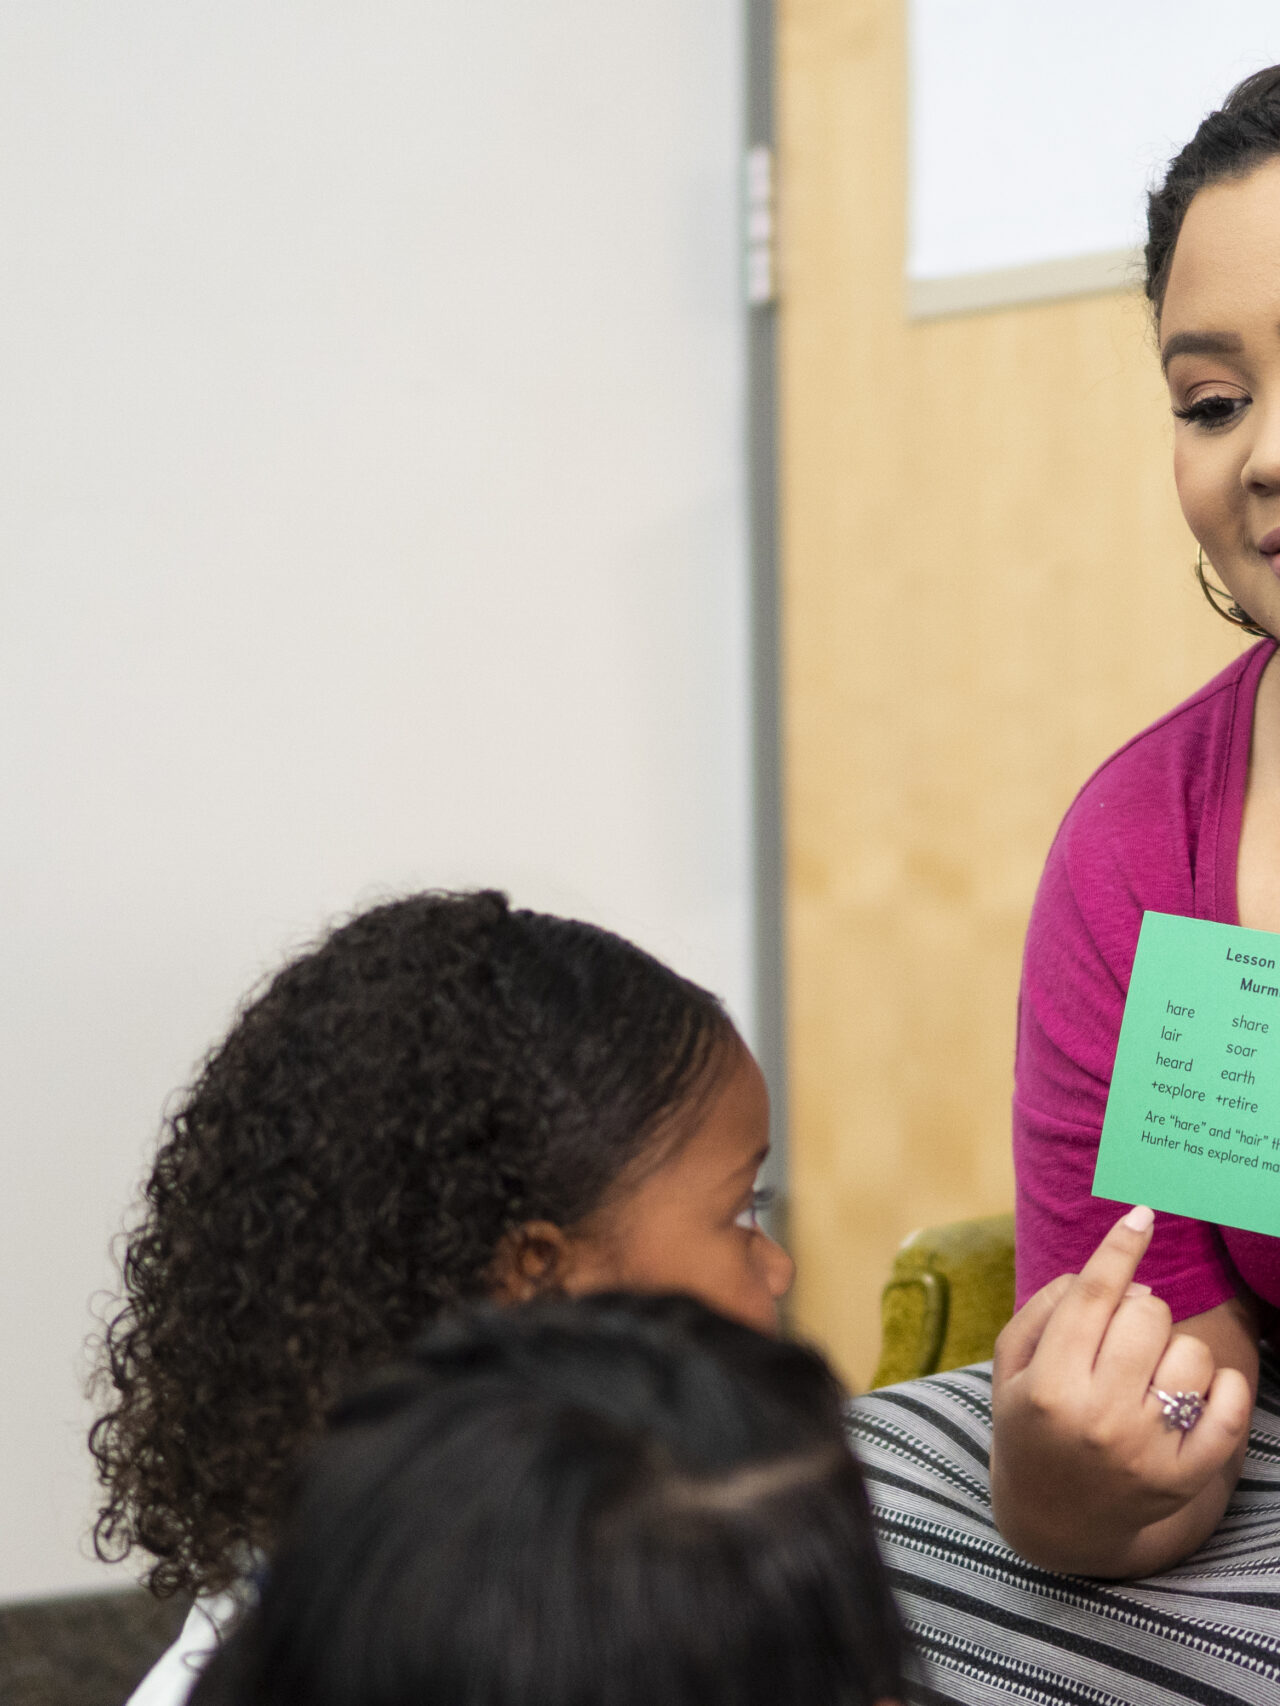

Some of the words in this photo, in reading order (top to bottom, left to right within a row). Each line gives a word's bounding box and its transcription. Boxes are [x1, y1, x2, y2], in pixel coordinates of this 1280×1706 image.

[1226, 948, 1275, 969] Lesson
[1166, 1000, 1195, 1018] hare
[1232, 1015, 1269, 1033] share
[1161, 1025, 1182, 1042] lair
[1226, 1043, 1257, 1057] soar
[1156, 1052, 1193, 1072] heard
[1221, 1070, 1255, 1085] earth
[1152, 1080, 1205, 1102] +explore
[1216, 1095, 1258, 1113] +retire
[1145, 1110, 1165, 1125] Are
[1209, 1128, 1231, 1140] and
[1141, 1130, 1180, 1150] Hunter
[1184, 1140, 1204, 1156] has
[1208, 1148, 1258, 1168] explored
